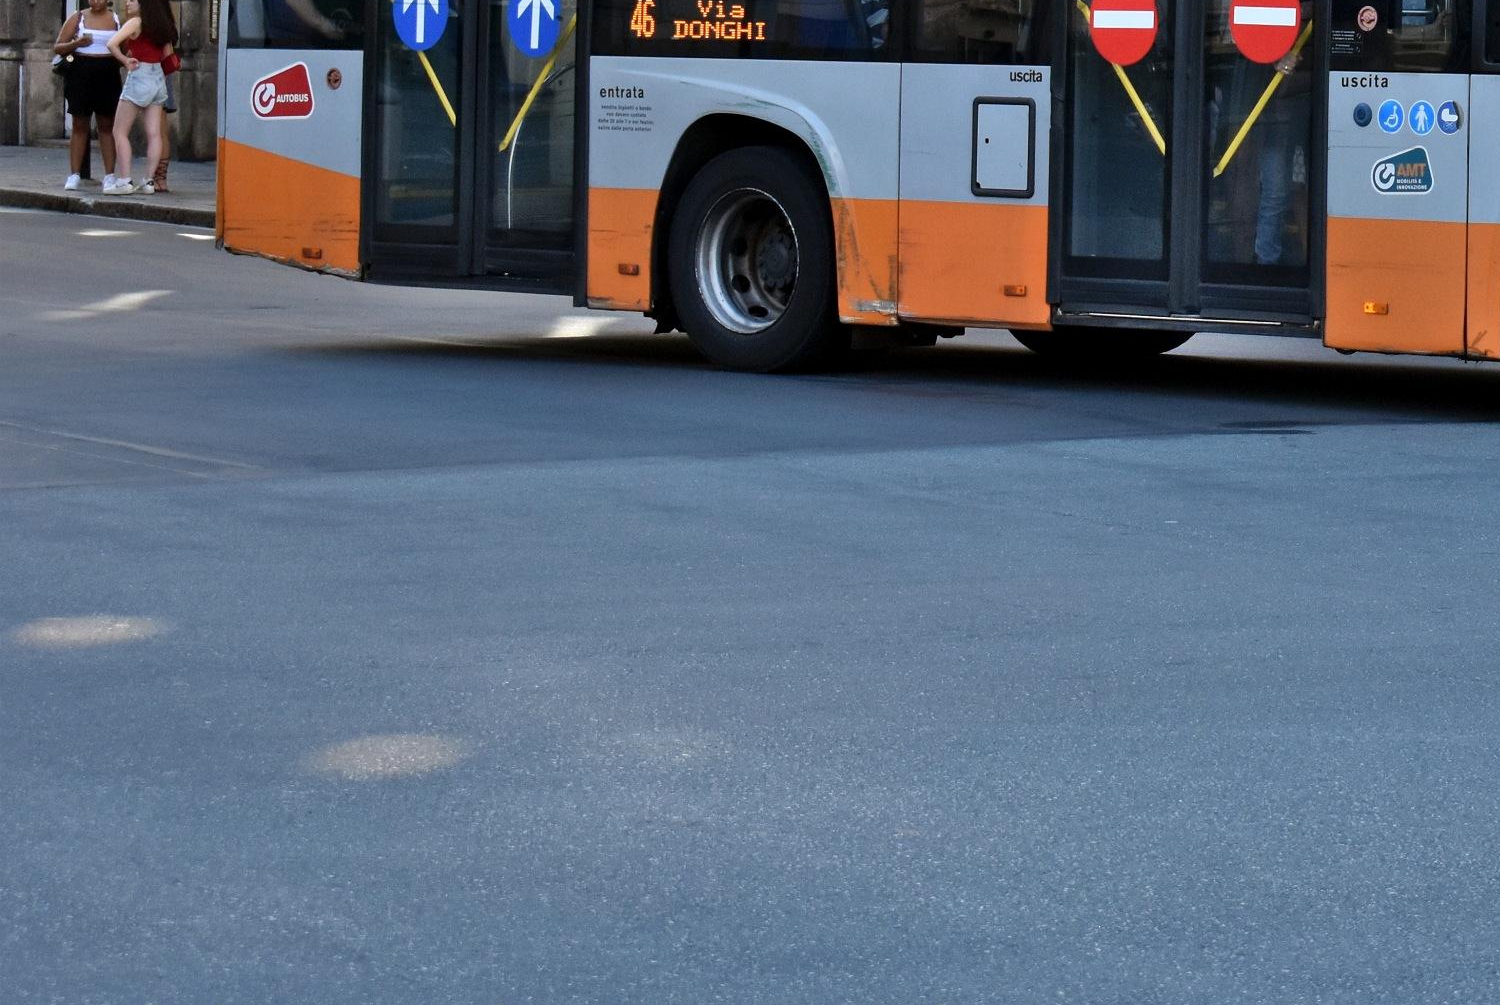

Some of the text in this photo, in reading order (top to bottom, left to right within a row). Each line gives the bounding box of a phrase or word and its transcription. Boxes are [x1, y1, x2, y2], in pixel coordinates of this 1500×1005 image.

[697, 0, 745, 18] Via
[630, 0, 656, 38] 46
[673, 20, 766, 40] DONGHI
[1009, 69, 1043, 83] uscita
[1341, 74, 1389, 88] uscita
[276, 93, 309, 103] AUTOBUS
[599, 86, 644, 99] entrata
[1397, 163, 1427, 178] AMT
